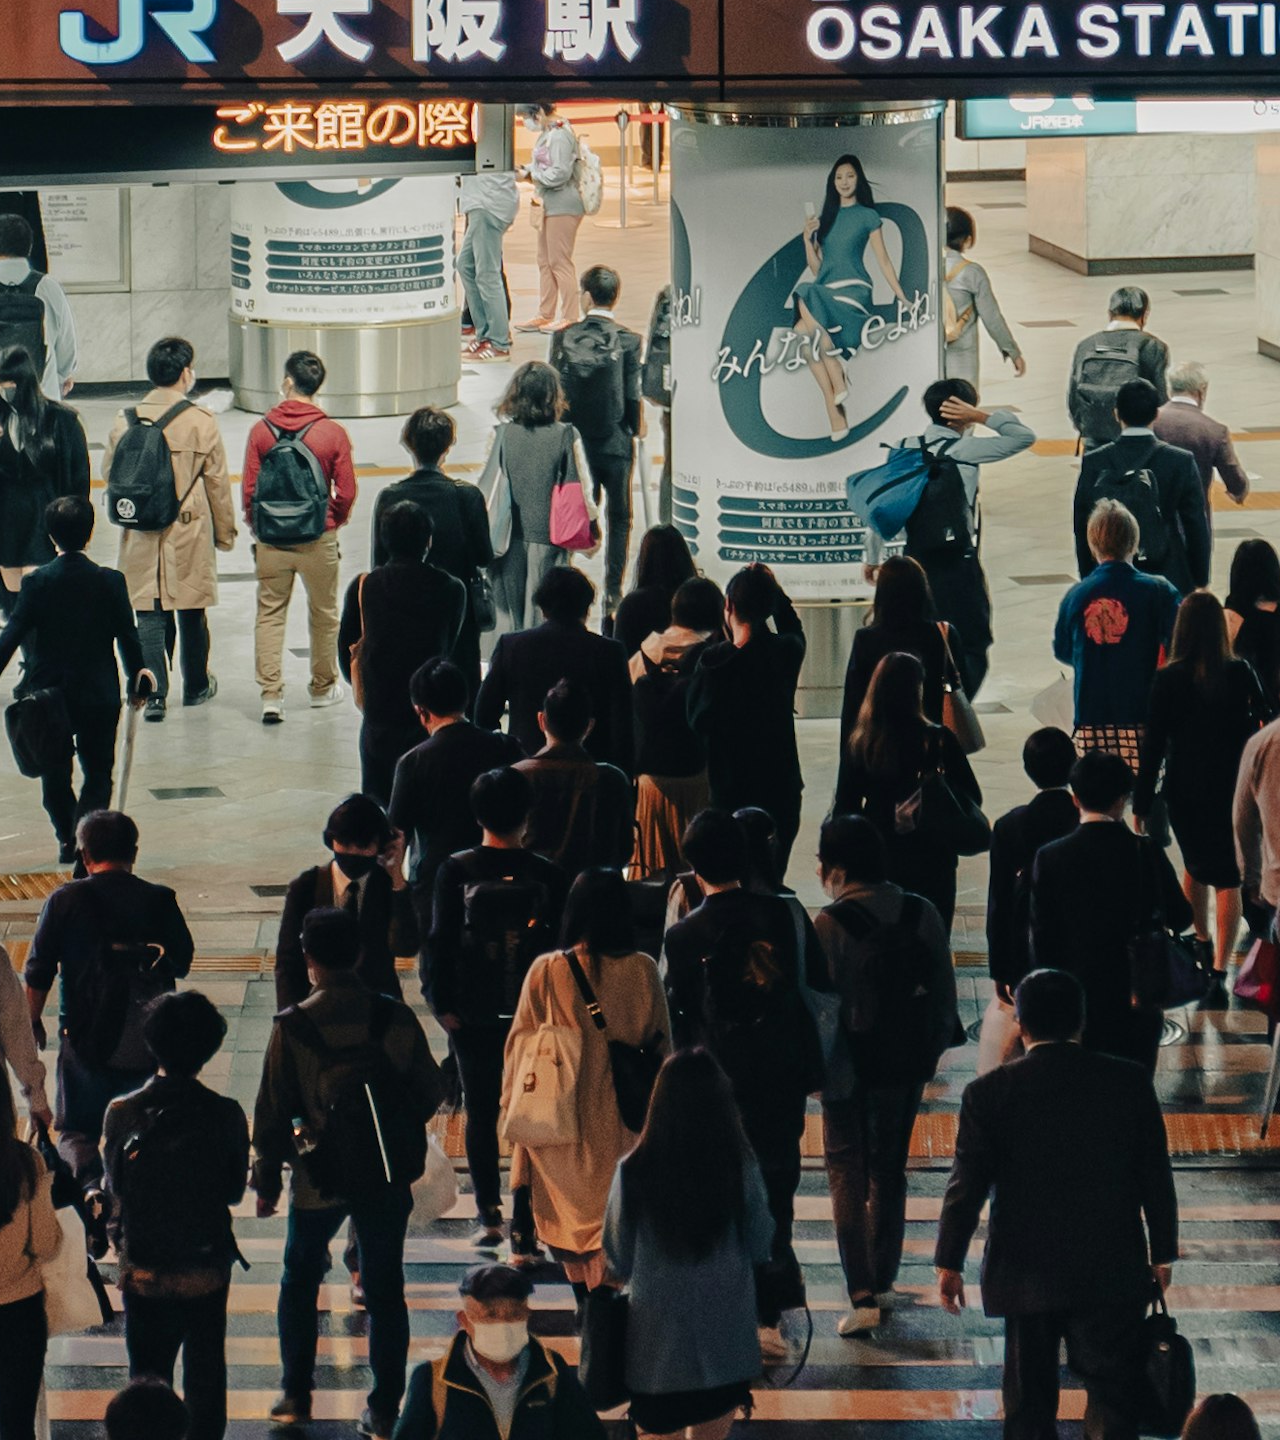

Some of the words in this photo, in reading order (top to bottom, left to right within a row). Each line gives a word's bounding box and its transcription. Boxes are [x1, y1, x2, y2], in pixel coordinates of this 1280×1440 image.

[213, 100, 480, 152] ご来館の際
